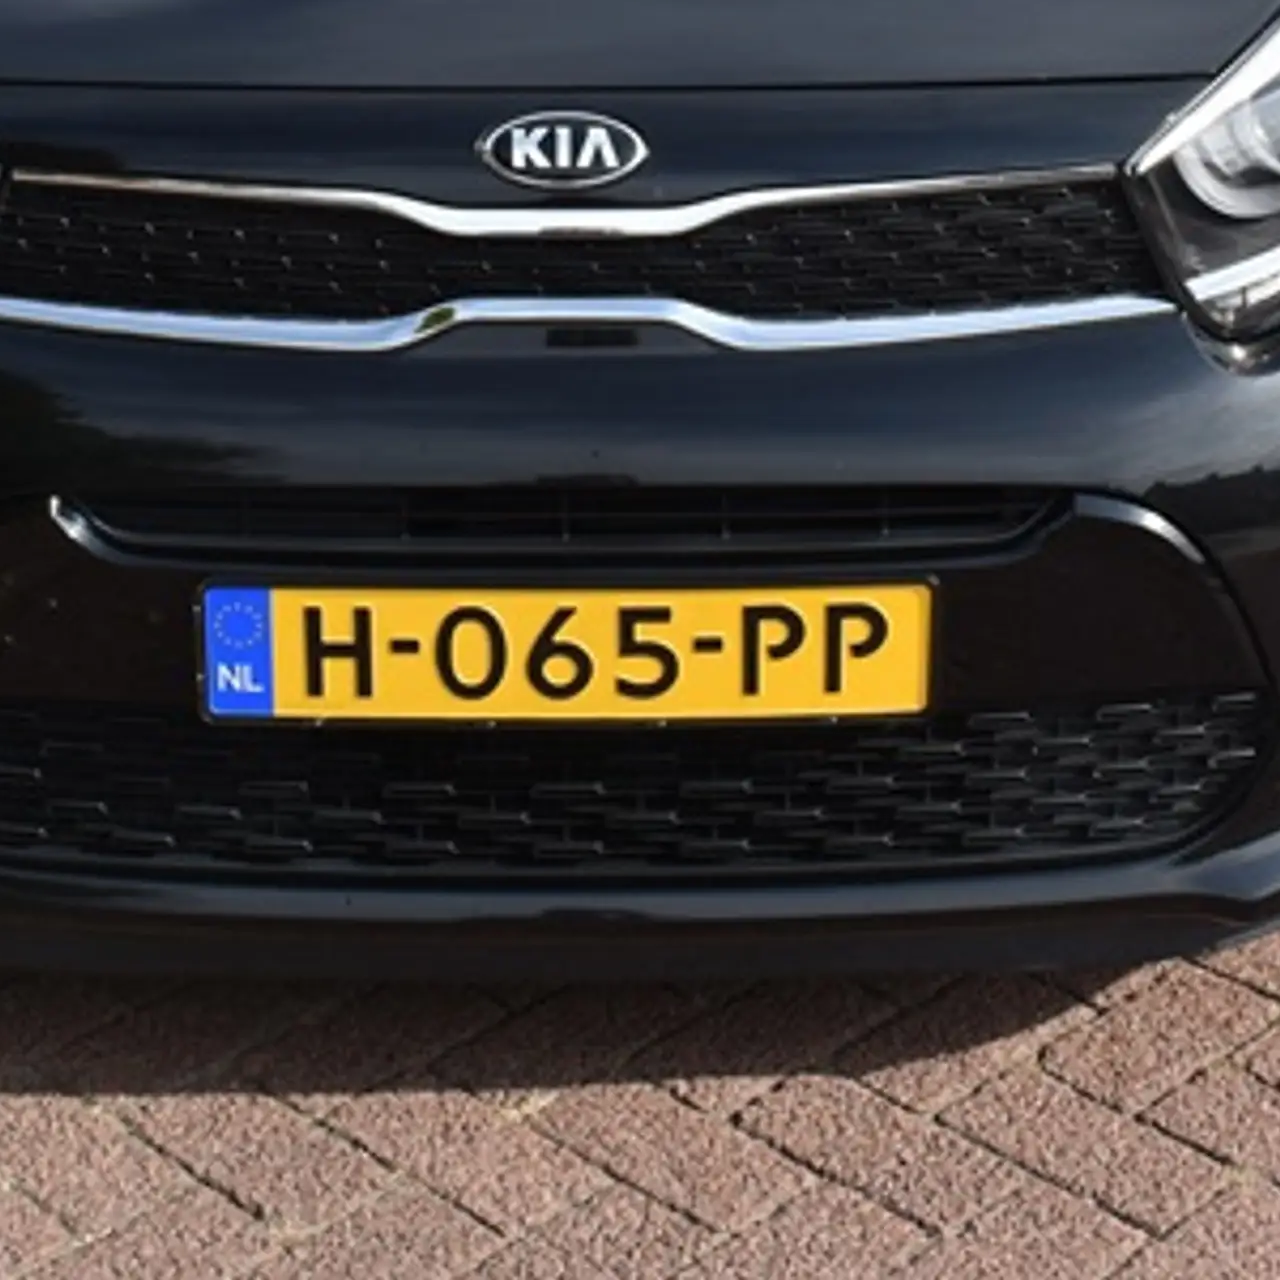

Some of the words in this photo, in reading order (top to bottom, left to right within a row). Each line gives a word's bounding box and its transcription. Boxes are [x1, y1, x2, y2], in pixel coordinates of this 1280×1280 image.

[509, 125, 620, 169] KIA
[303, 602, 889, 700] H-065-PP
[216, 661, 266, 694] NL
